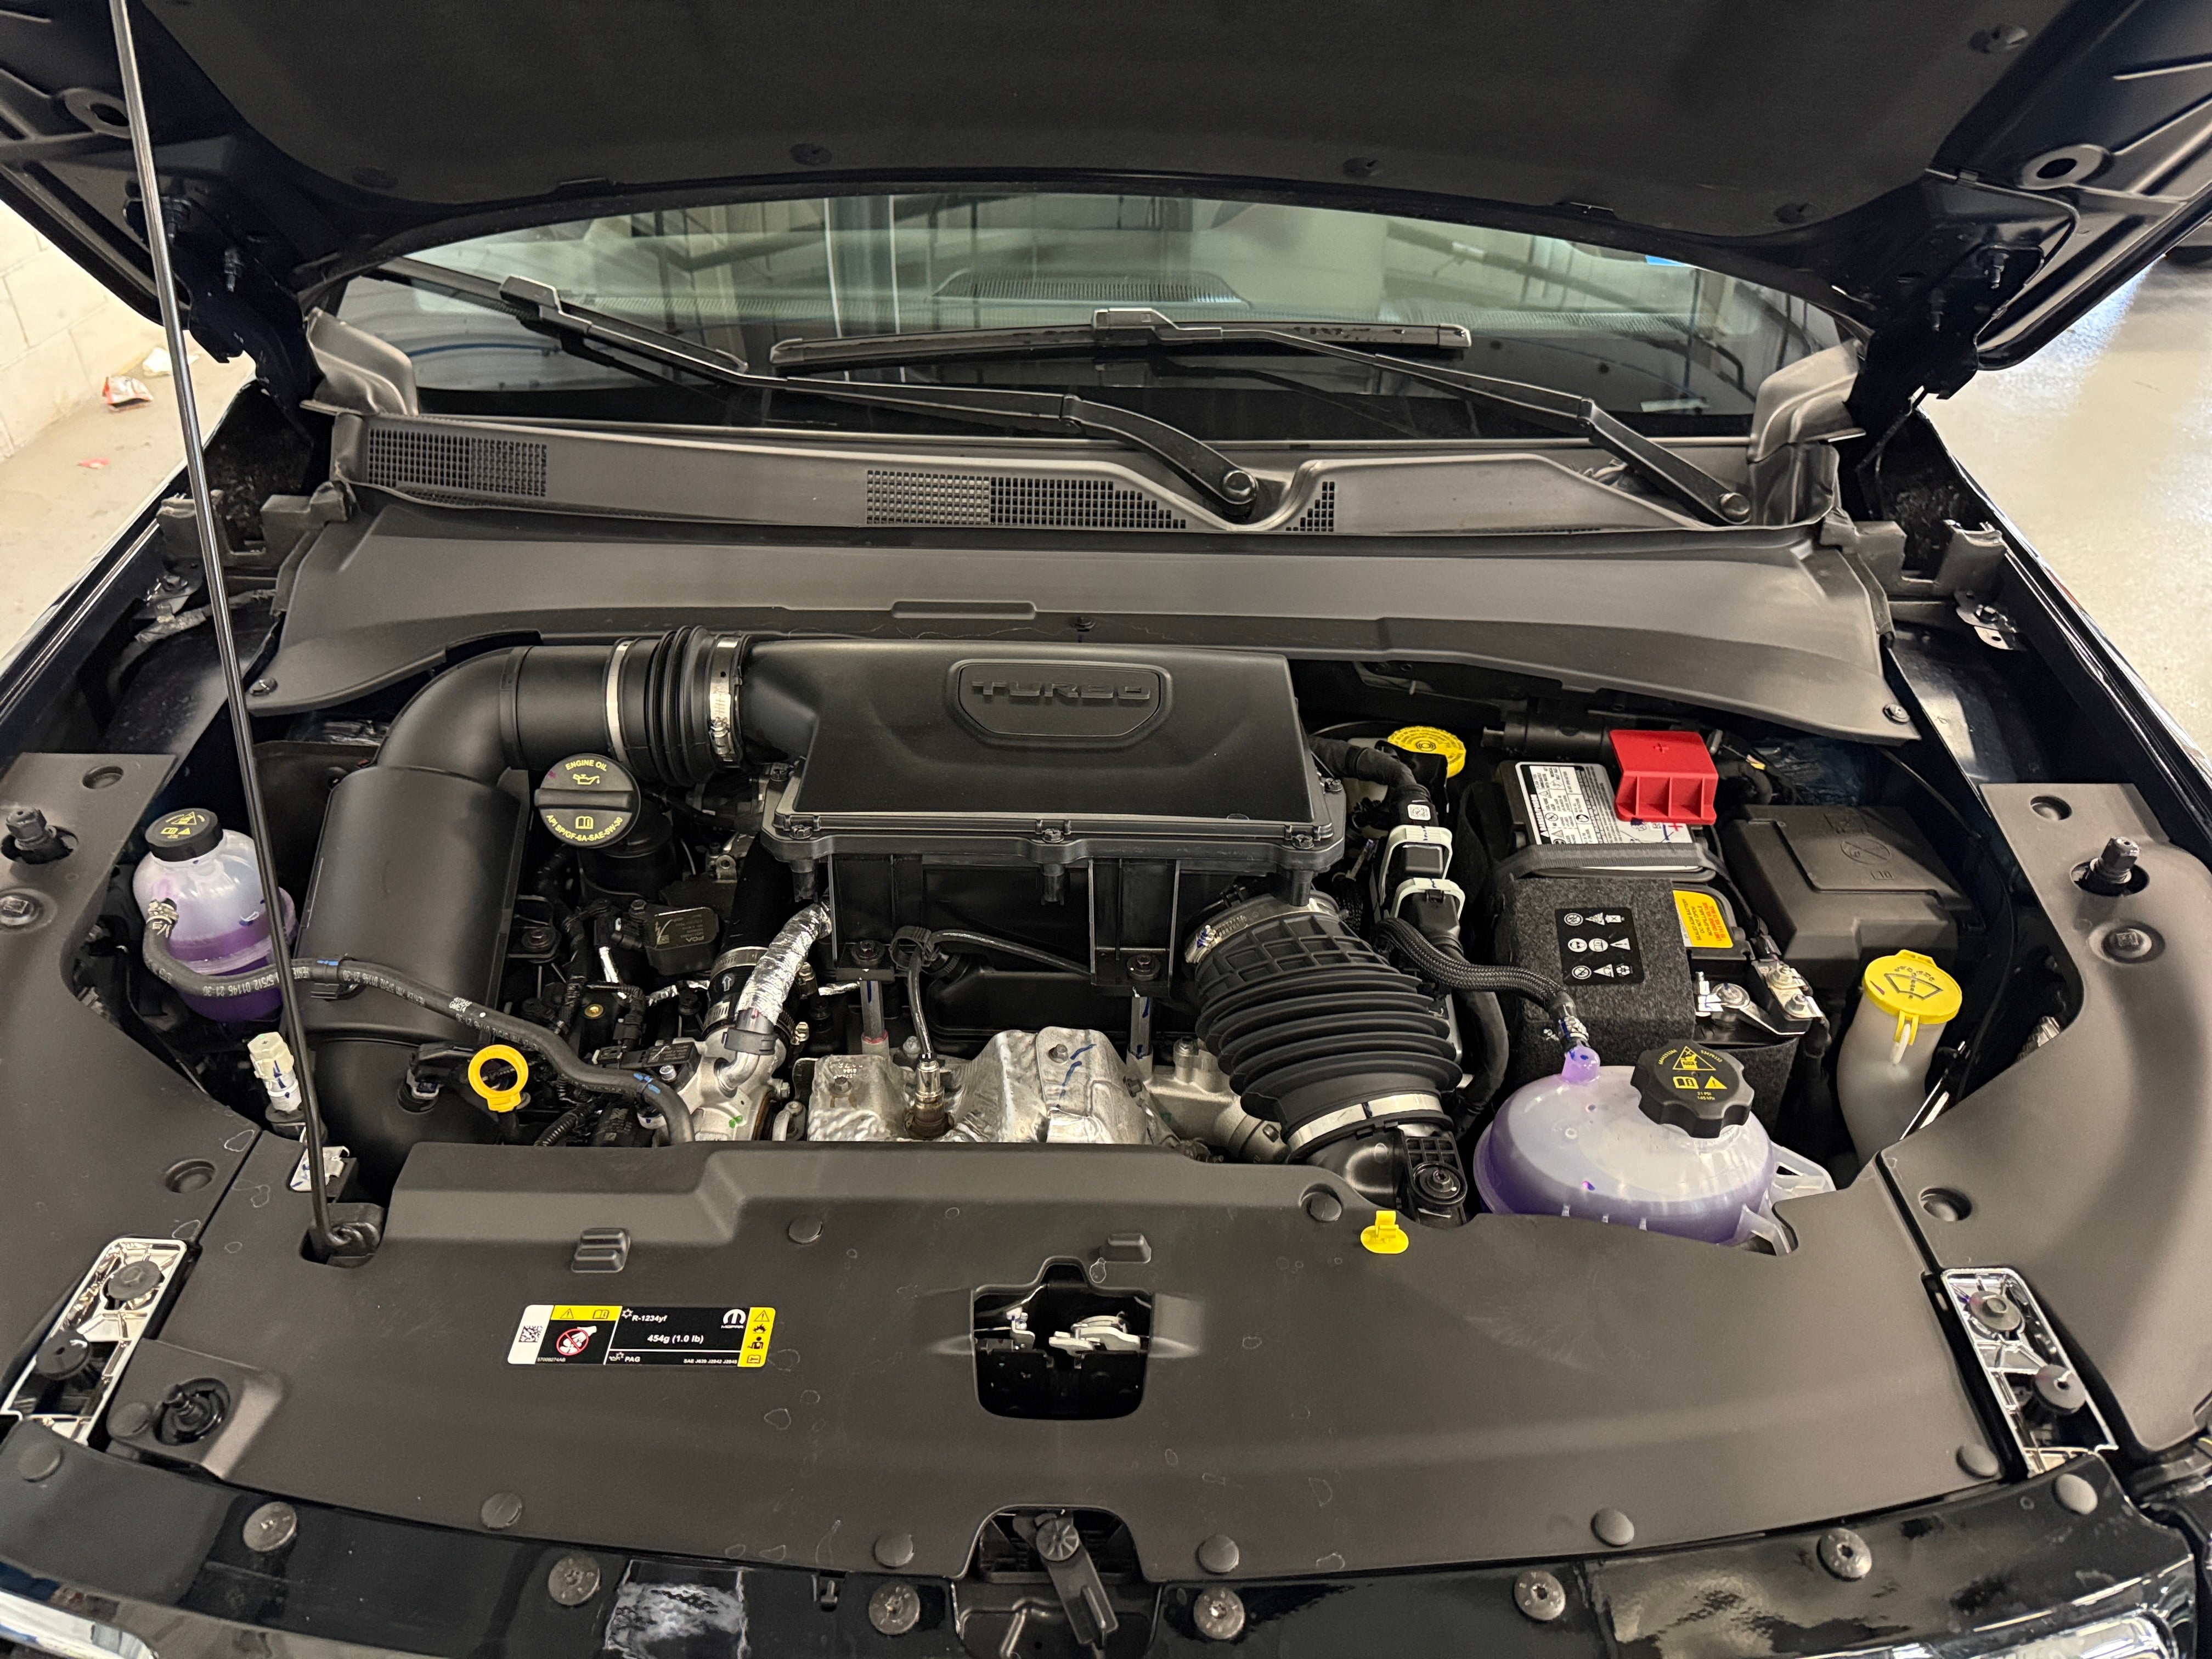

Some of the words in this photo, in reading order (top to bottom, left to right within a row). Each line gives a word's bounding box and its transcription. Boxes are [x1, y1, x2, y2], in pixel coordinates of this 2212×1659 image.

[972, 681, 1150, 701] TURBO
[565, 759, 595, 771] ENGINE
[596, 761, 607, 772] OIL
[546, 815, 558, 827] API
[1681, 899, 1691, 916] BATTERY
[647, 1334, 670, 1344] 454g
[672, 1335, 690, 1344] (1.0
[691, 1335, 704, 1344] lb)
